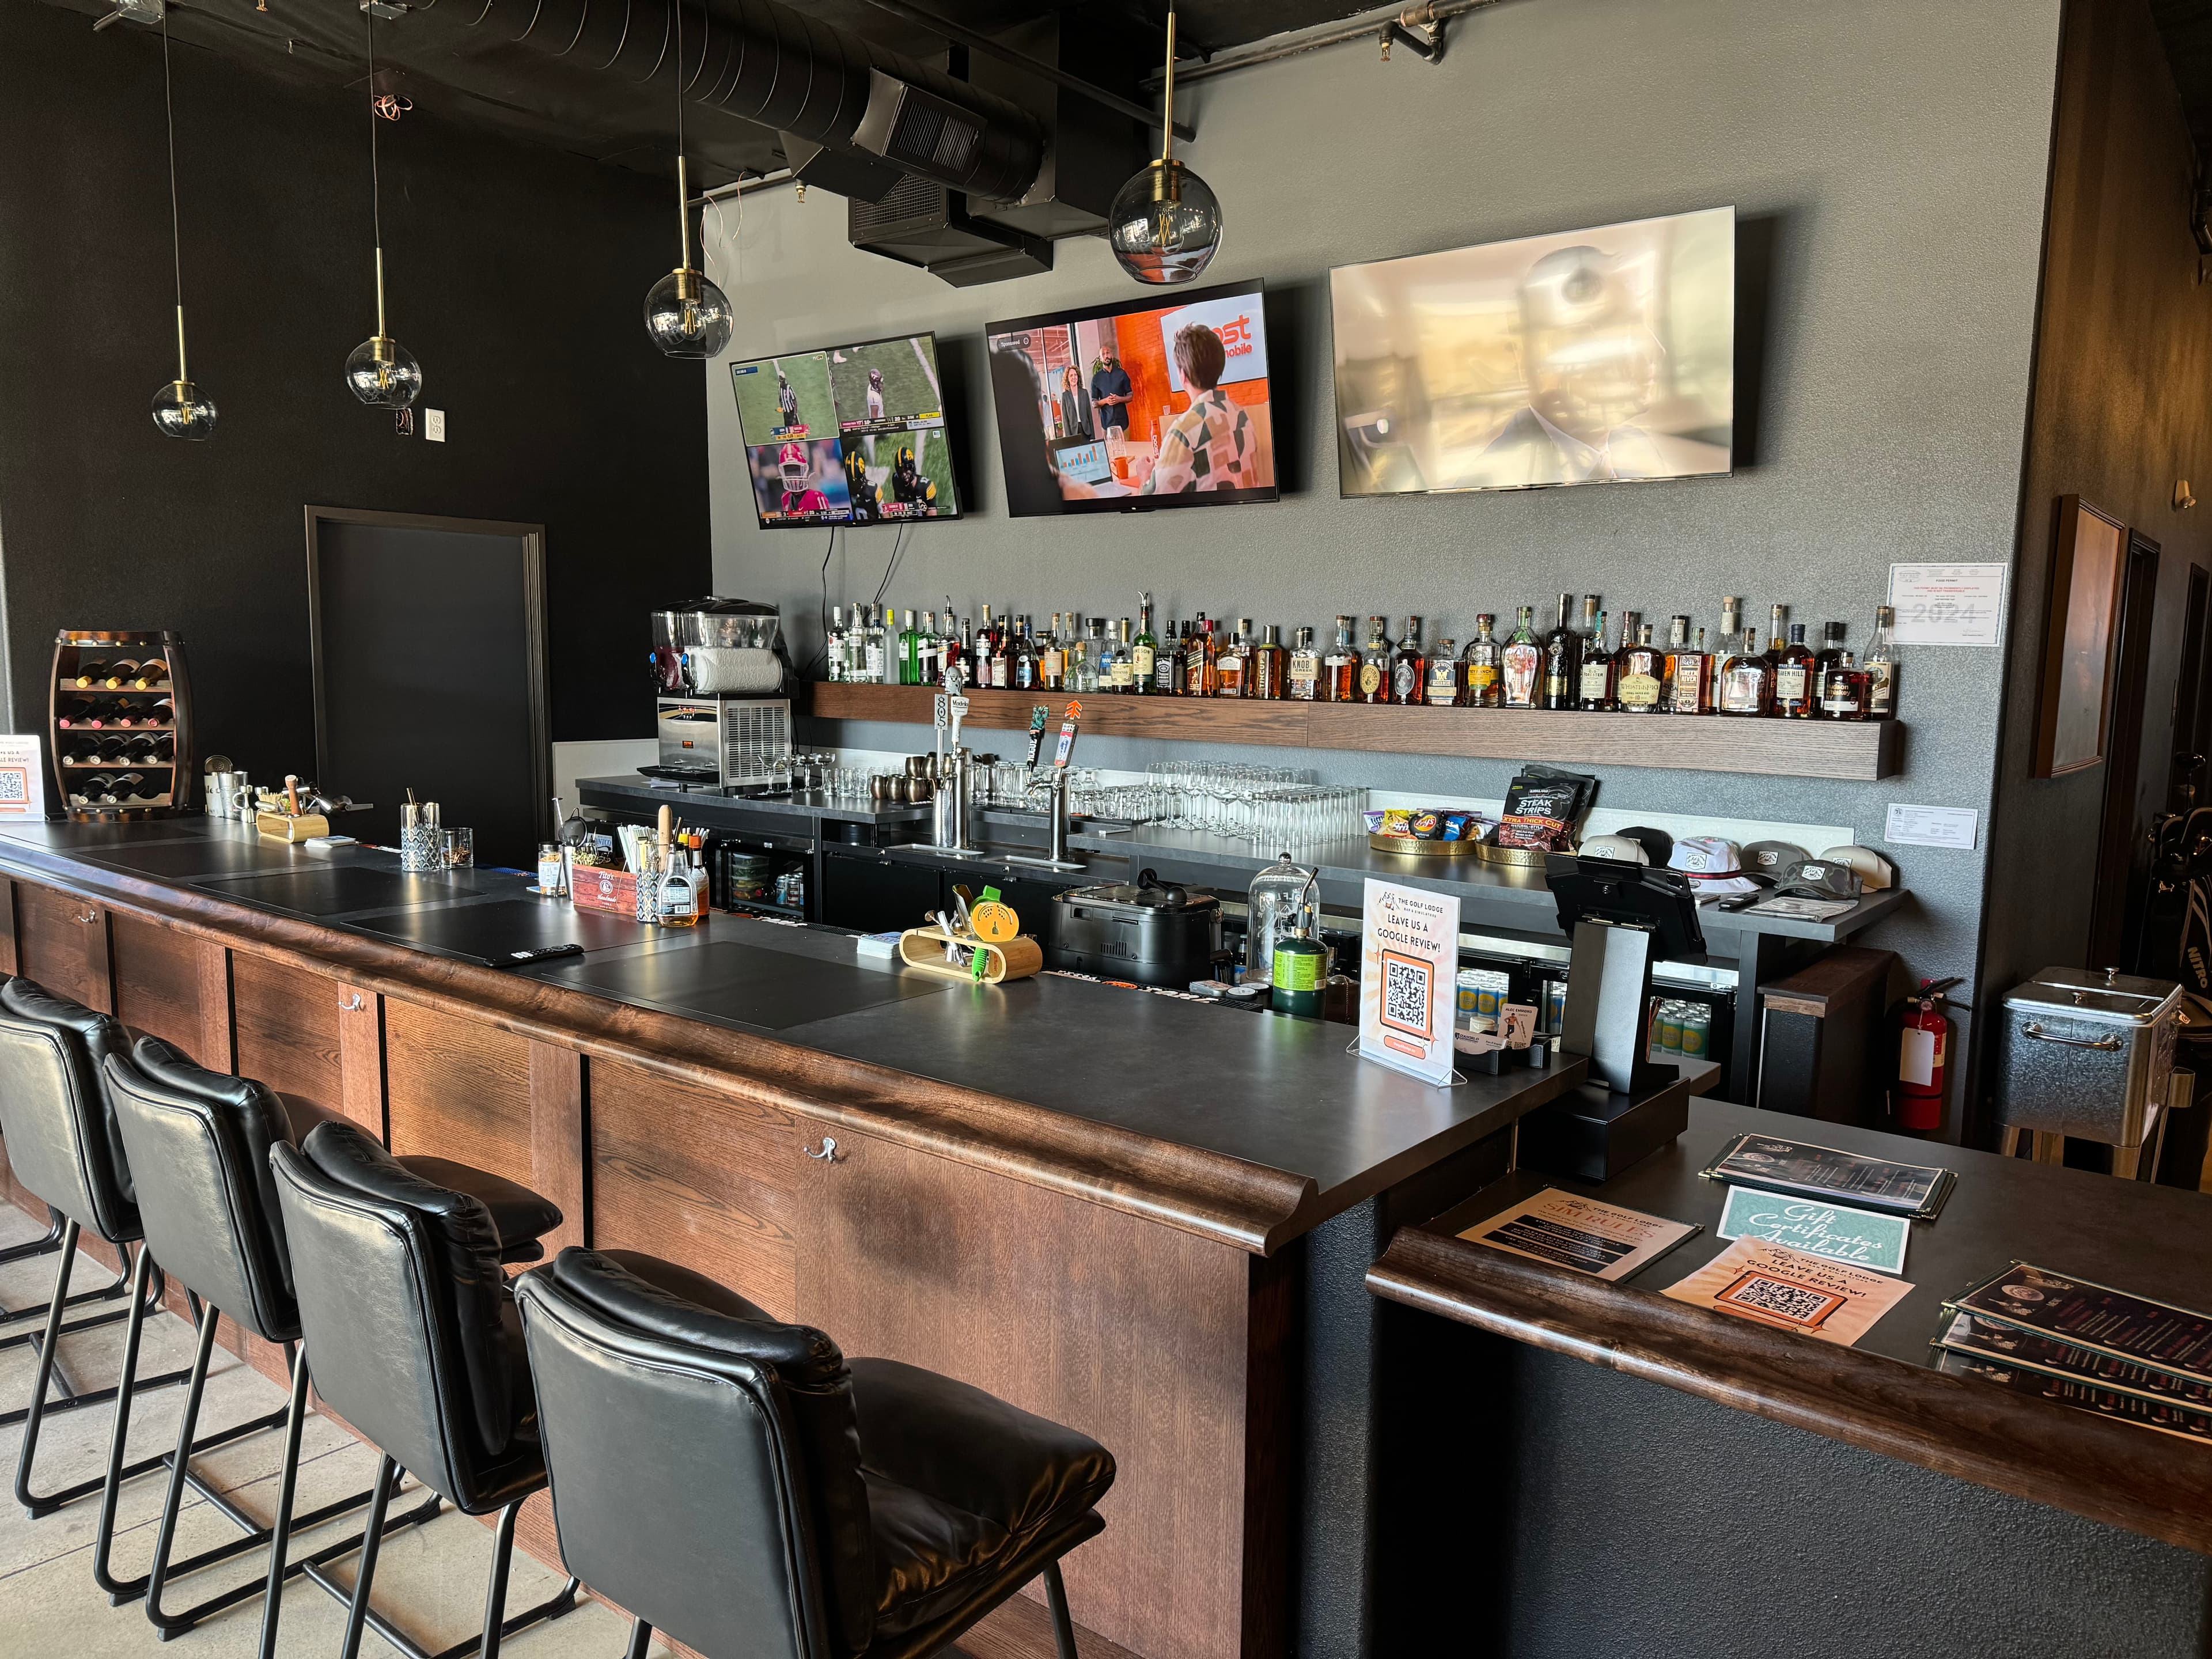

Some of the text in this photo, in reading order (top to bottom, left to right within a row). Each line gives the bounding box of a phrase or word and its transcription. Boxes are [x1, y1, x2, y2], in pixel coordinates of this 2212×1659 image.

[1212, 315, 1251, 344] ost
[1001, 339, 1020, 347] Sponsored
[1911, 603, 1976, 623] 2024
[1293, 660, 1309, 669] KNOB
[937, 697, 946, 727] 805
[1515, 806, 1552, 815] STRIPS
[1520, 800, 1553, 808] STEAK
[1546, 820, 1561, 829] CUT
[599, 871, 614, 880] Tito's
[1425, 904, 1443, 913] LODGE
[1388, 914, 1428, 932] LEAVE US A
[1378, 928, 1441, 952] GOOGLE REVIEW!
[1540, 1203, 1658, 1238] SIM RULES
[1609, 1212, 1634, 1220] GOLF
[1633, 1218, 1664, 1228] LODGE
[1783, 1205, 1838, 1225] Gift
[1749, 1213, 1883, 1249] Certificates
[1739, 1229, 1870, 1261] Available
[1747, 1259, 1866, 1297] GOOGLE REVIEW!
[1771, 1259, 1813, 1274] LEAVE
[1817, 1272, 1835, 1281] US
[1821, 1264, 1846, 1274] GOLF
[1849, 1272, 1884, 1284] LODGE
